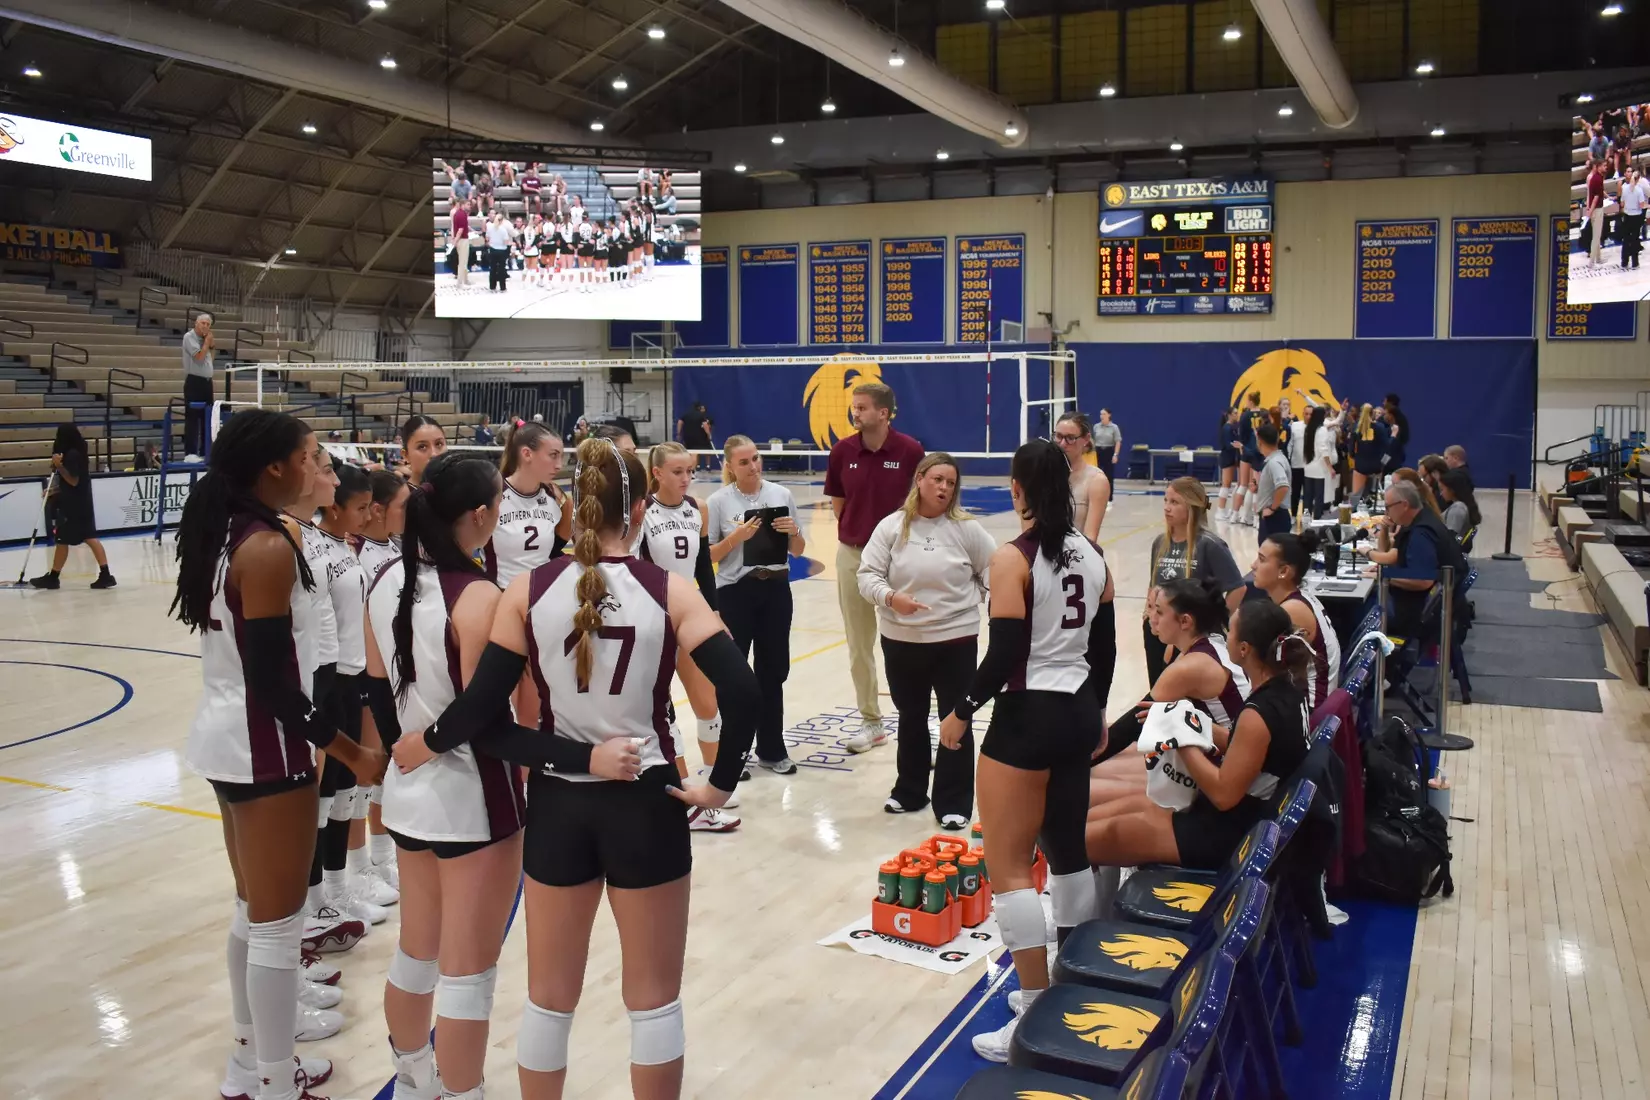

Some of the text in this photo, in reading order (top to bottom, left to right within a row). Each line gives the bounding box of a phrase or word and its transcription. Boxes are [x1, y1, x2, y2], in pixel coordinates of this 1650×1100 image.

[71, 146, 135, 169] Greenville
[1129, 180, 1268, 198] EAST TEXAS A&M
[1234, 209, 1262, 220] BUD
[1228, 219, 1268, 230] LIGHT
[1100, 247, 1110, 255] 02
[1235, 243, 1246, 251] 03
[1363, 247, 1396, 257] 2007
[1459, 244, 1493, 254] 2007
[992, 259, 1019, 267] 2022
[1180, 262, 1187, 270] 4
[1215, 259, 1226, 271] 10
[1362, 259, 1392, 268] 2019
[1459, 256, 1493, 266] 2020
[1362, 270, 1395, 280] 2020
[1458, 268, 1489, 278] 2021
[1202, 277, 1208, 287] 2
[1219, 277, 1226, 287] 2
[1362, 282, 1392, 291] 2021
[962, 291, 990, 299] 2005
[1362, 293, 1395, 302] 2022
[1556, 314, 1587, 323] 2018
[1555, 326, 1587, 335] 2021
[883, 461, 899, 469] SIU
[128, 476, 190, 500] Allinc
[500, 510, 531, 525] SOUTHERN
[651, 521, 680, 537] SOUTHERN
[524, 526, 539, 551] 2
[674, 536, 688, 559] 9
[1060, 574, 1086, 629] 3
[1163, 763, 1196, 789] GATO
[964, 875, 976, 890] G
[894, 913, 910, 934] G
[939, 951, 970, 962] G
